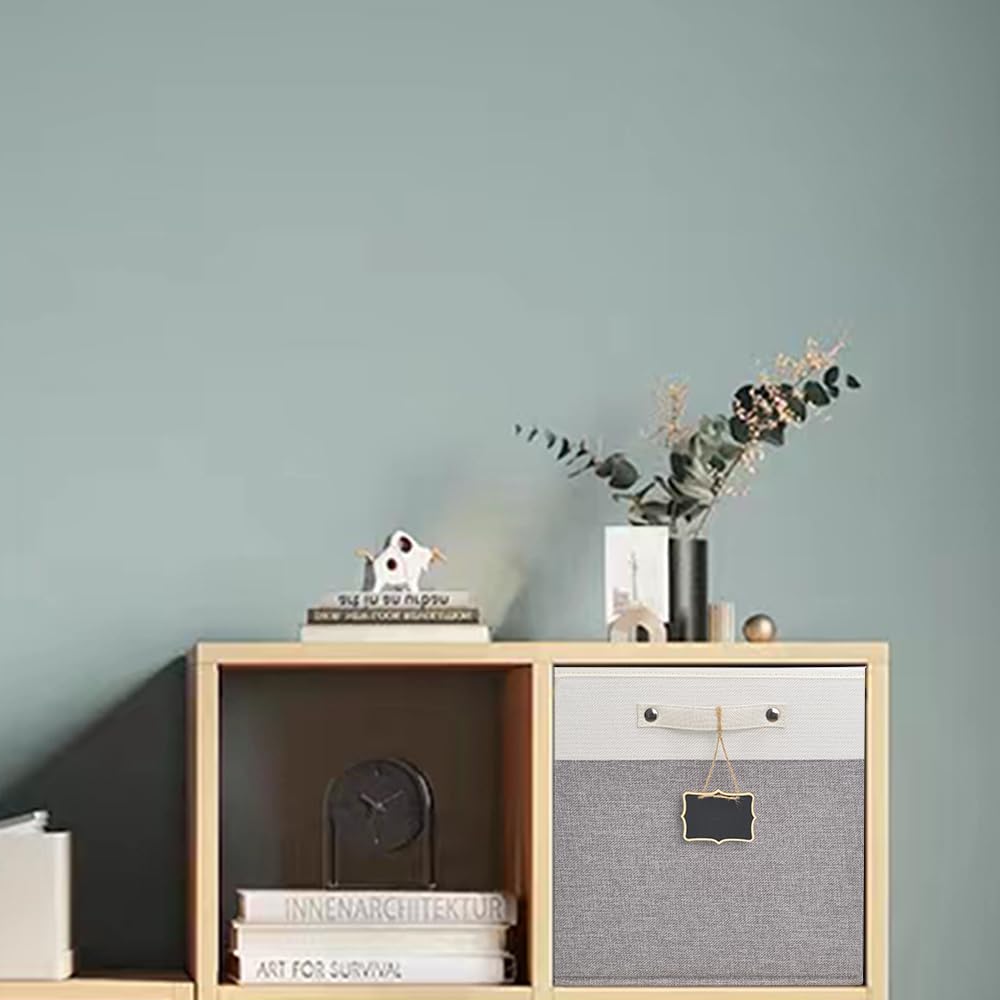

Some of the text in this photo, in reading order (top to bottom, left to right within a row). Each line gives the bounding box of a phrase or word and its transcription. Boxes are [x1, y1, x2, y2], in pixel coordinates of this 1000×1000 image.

[284, 897, 503, 922] INNENARCHITEKTUR
[256, 959, 402, 980] ART FOR SURVIVAL
